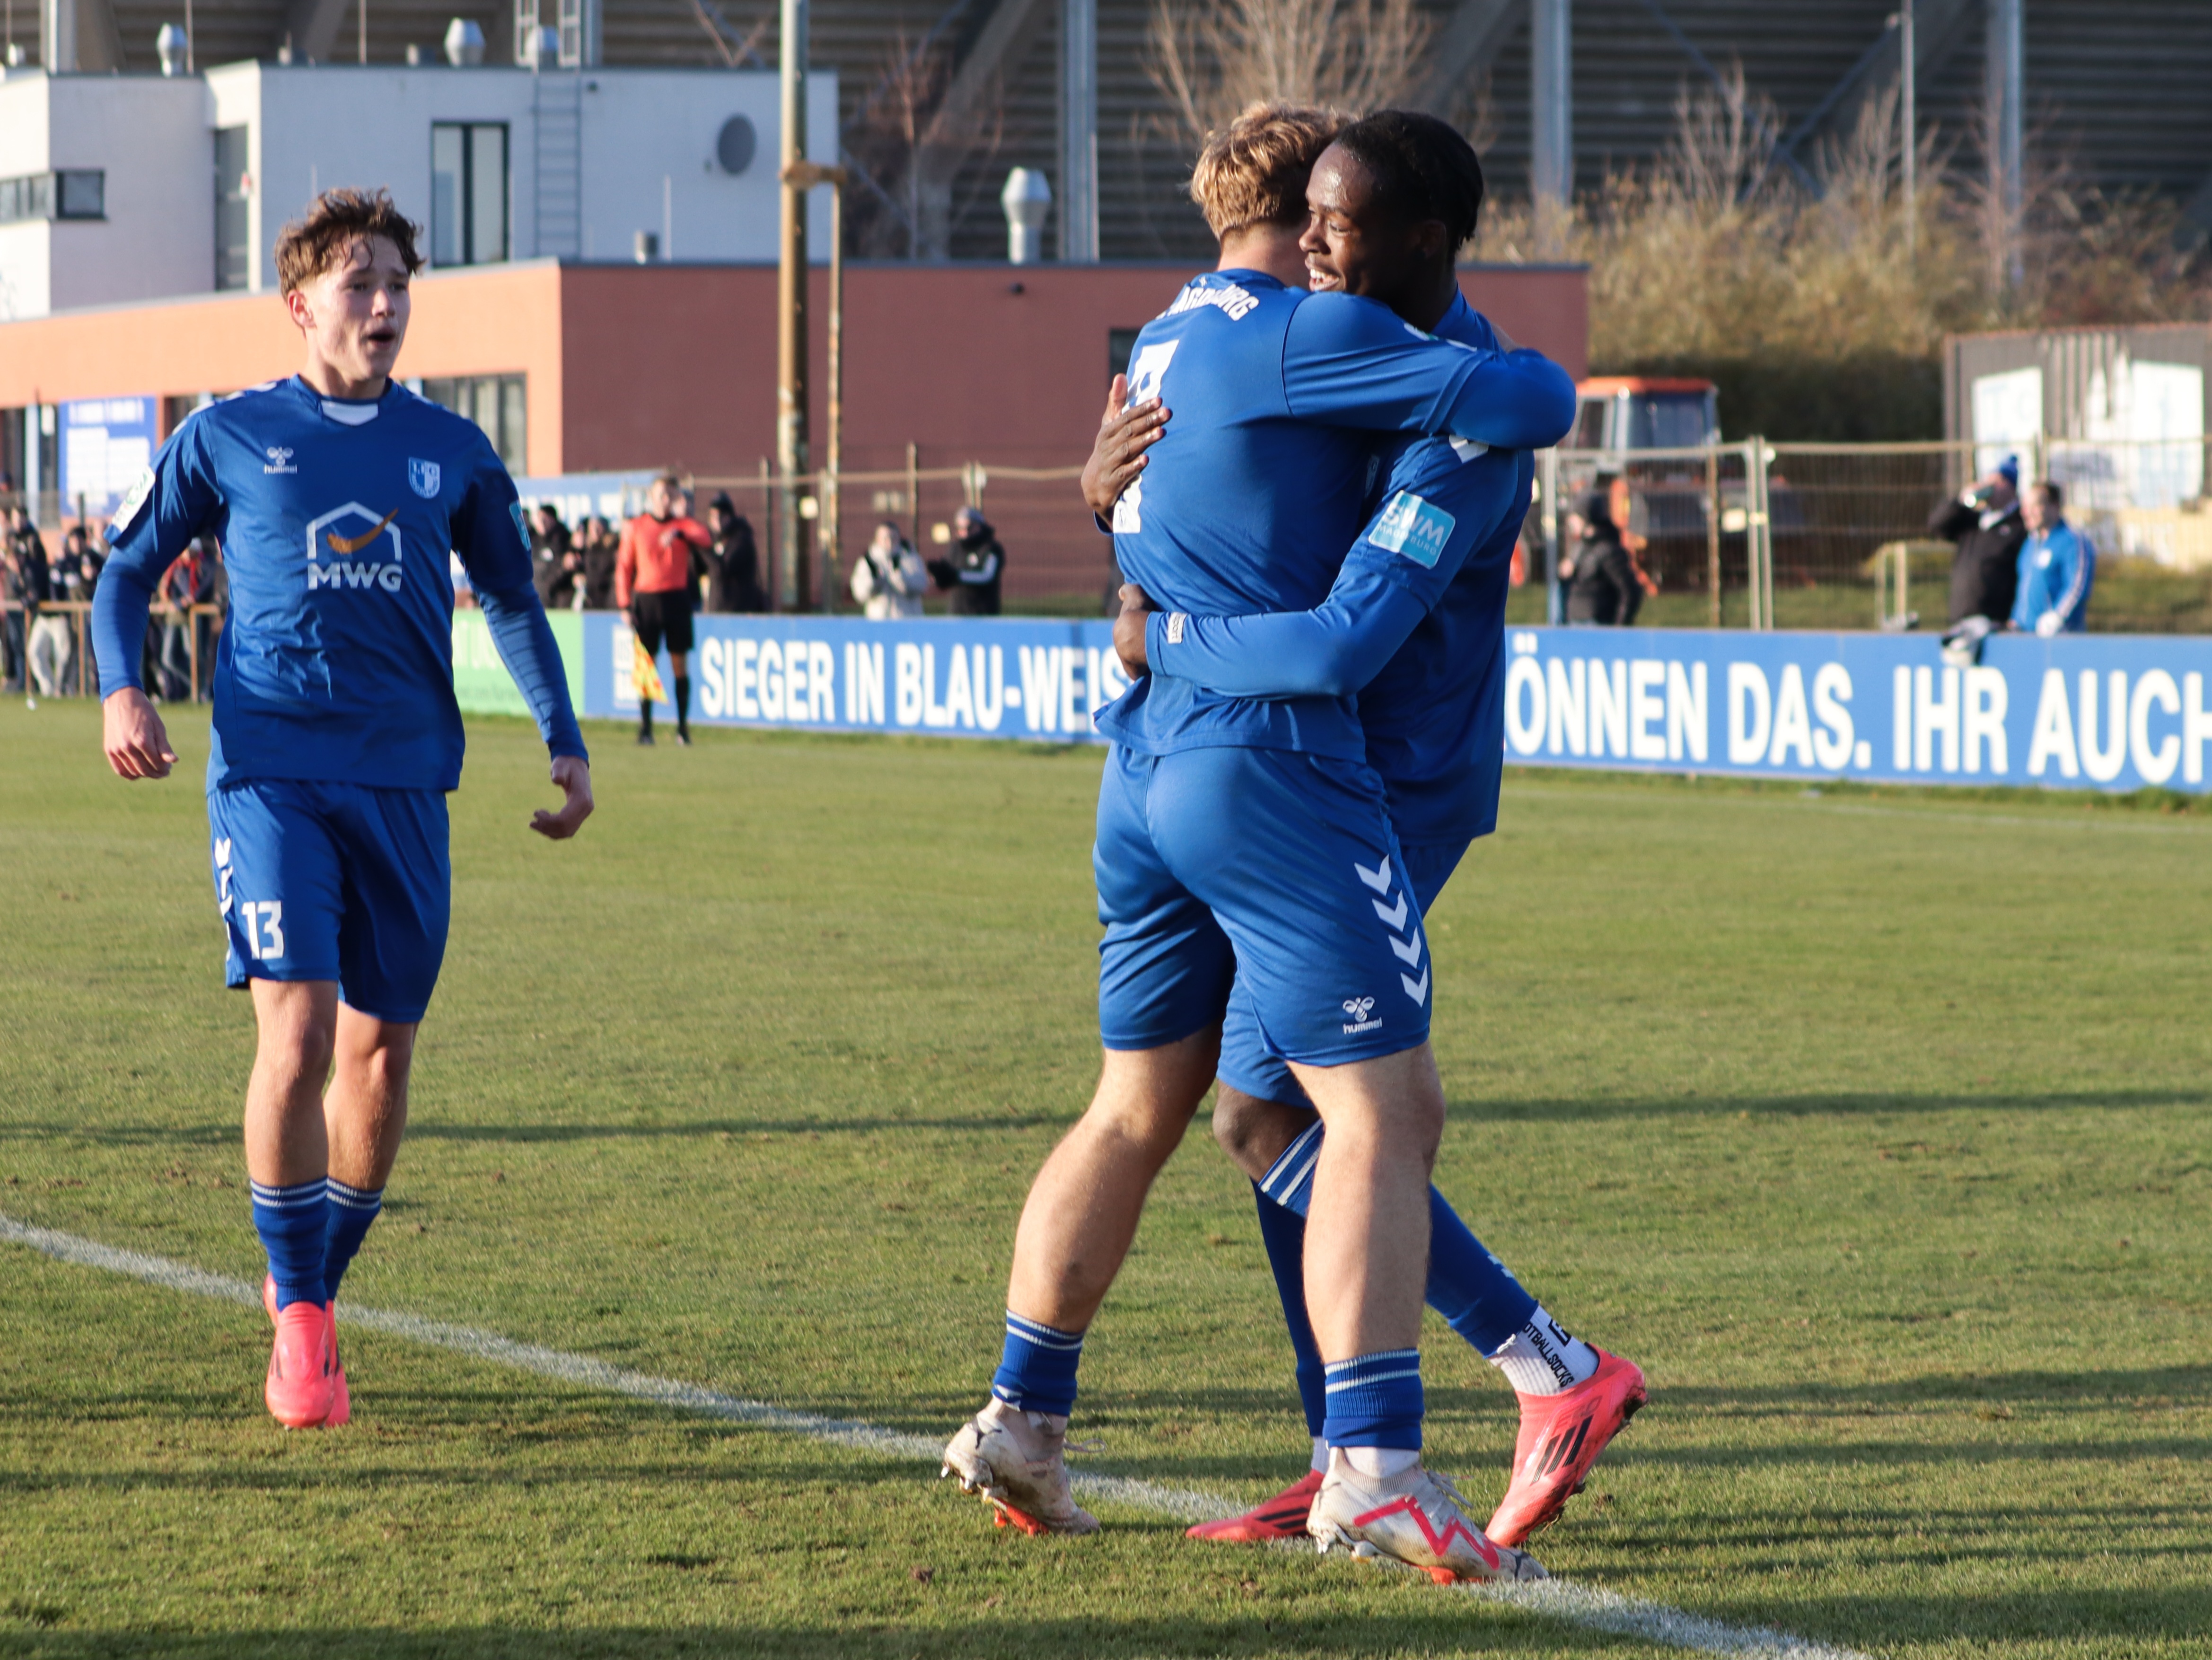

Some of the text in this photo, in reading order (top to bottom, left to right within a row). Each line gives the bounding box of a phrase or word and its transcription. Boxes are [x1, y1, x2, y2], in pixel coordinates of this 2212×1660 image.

[263, 463, 297, 474] hummel
[1382, 502, 1445, 549] SWM
[307, 562, 402, 592] MWG
[699, 636, 835, 723] SIEGER
[844, 641, 886, 725] IN
[1504, 632, 2212, 785] ÖNNEN DAS. IHR AUCH
[241, 900, 284, 960] 13
[1343, 1017, 1383, 1035] hummel
